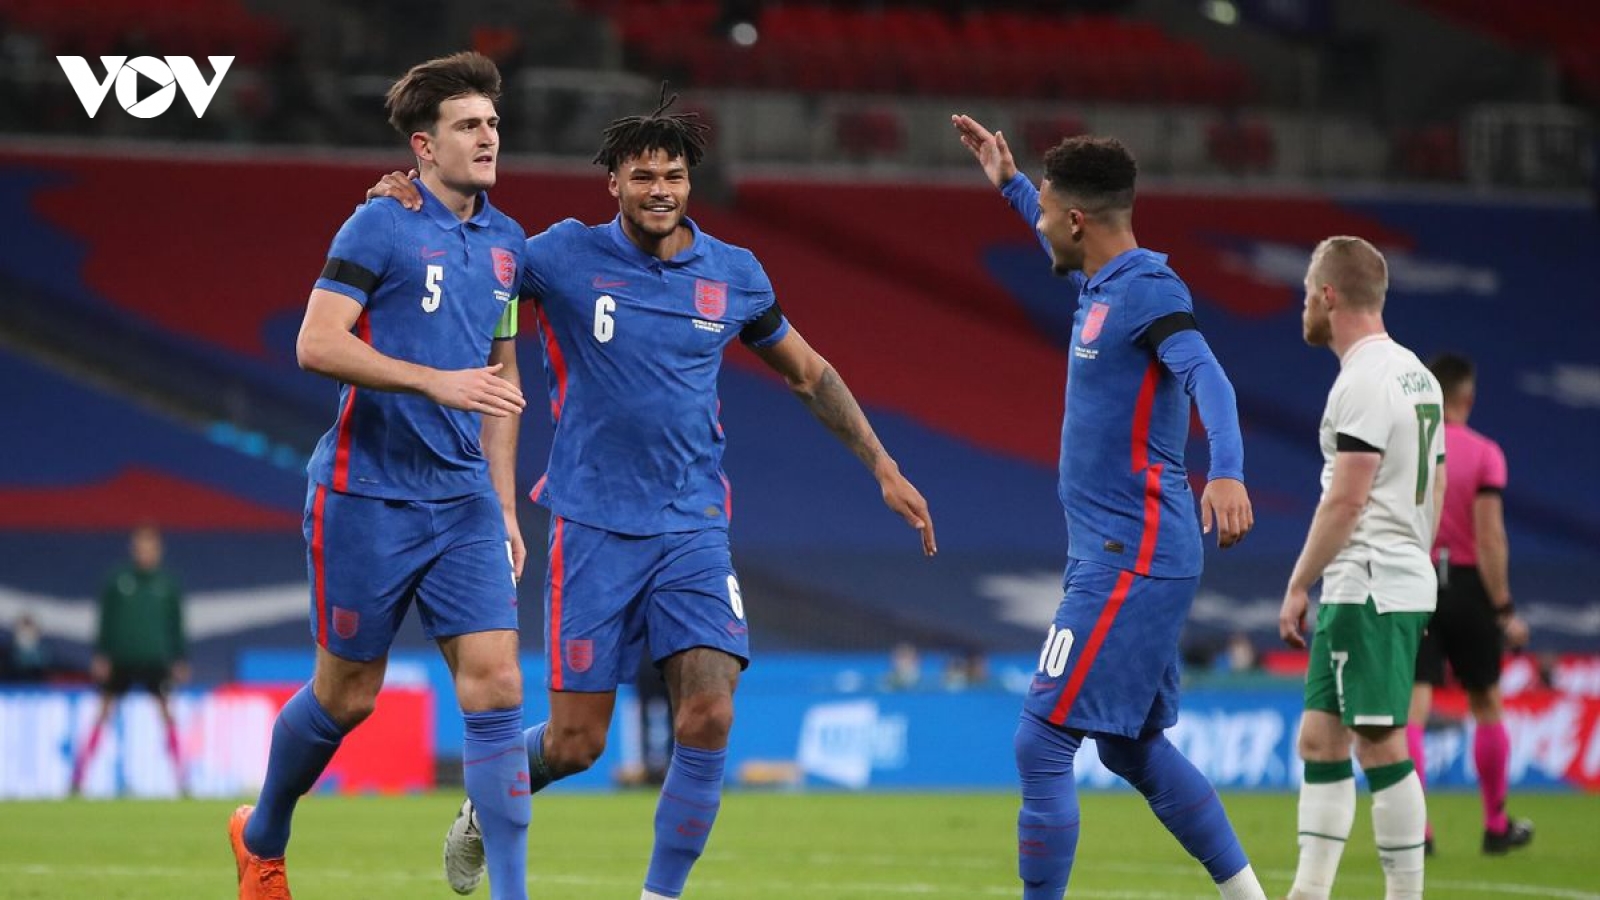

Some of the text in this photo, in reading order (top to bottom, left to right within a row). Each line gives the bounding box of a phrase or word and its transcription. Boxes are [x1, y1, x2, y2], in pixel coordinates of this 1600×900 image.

[421, 264, 443, 313] 5
[593, 295, 616, 343] 6
[1397, 371, 1433, 396] HOGAN
[1414, 403, 1441, 507] 17
[727, 575, 744, 620] 6
[1038, 623, 1075, 678] 10
